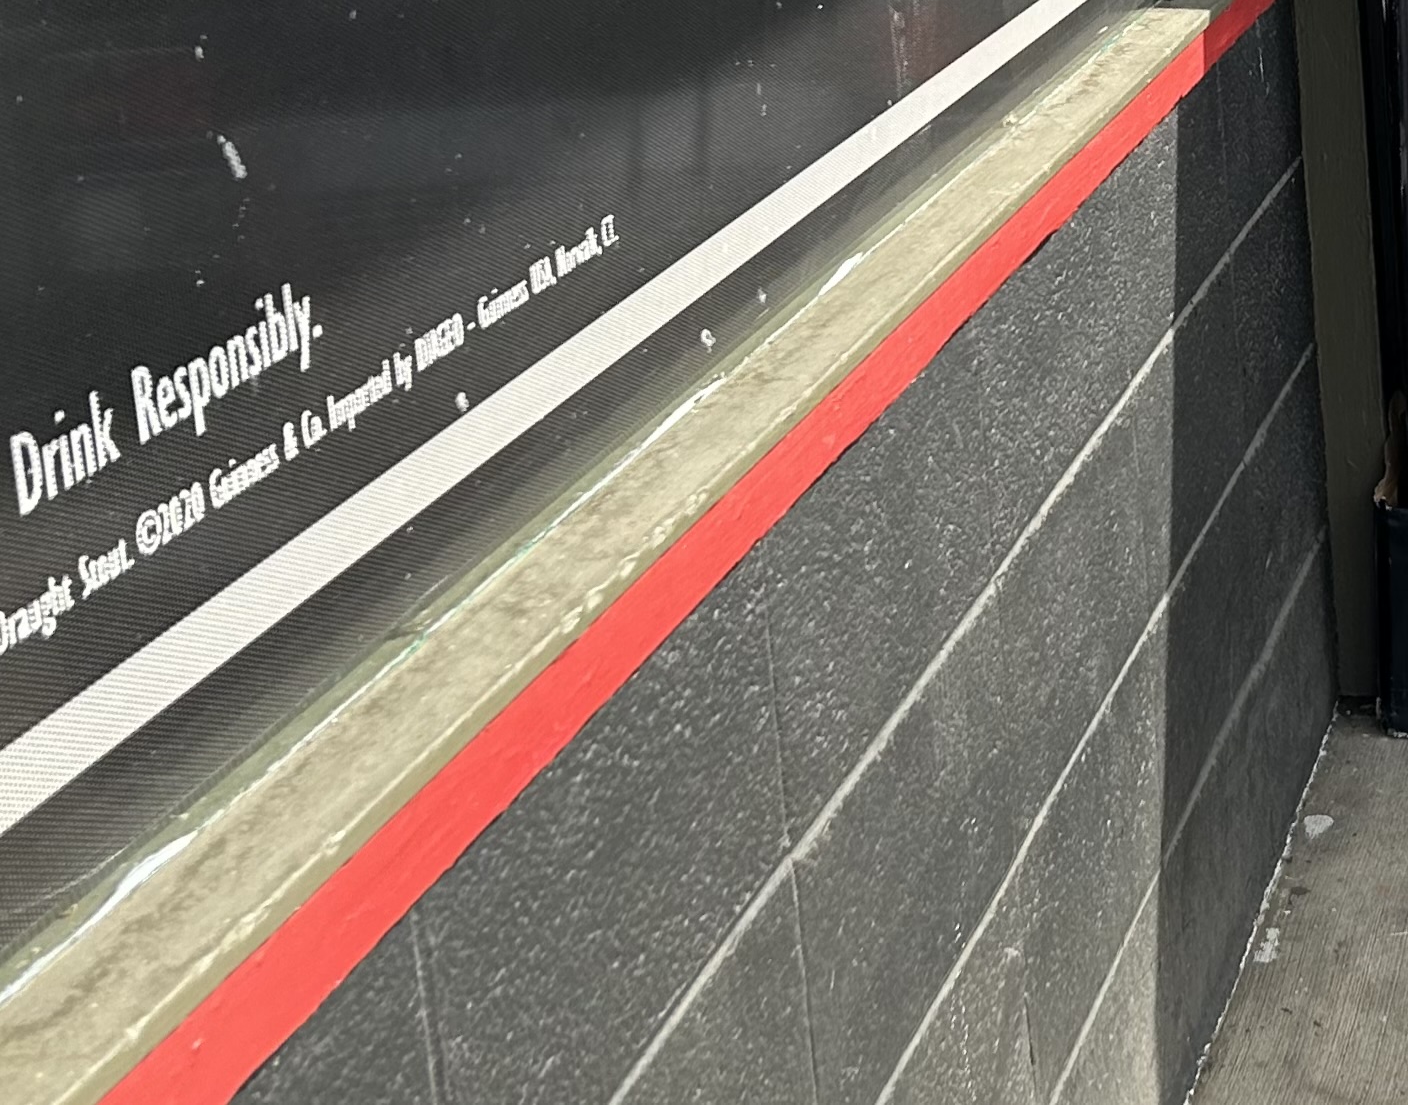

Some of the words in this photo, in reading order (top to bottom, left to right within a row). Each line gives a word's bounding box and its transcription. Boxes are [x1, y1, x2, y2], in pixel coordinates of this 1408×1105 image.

[10, 390, 121, 516] Drink
[131, 282, 323, 445] Responsibly.
[209, 444, 280, 509] Guinness
[282, 421, 300, 461] &
[326, 358, 392, 431] Imported
[393, 352, 412, 391] by
[477, 279, 530, 330] Guinness
